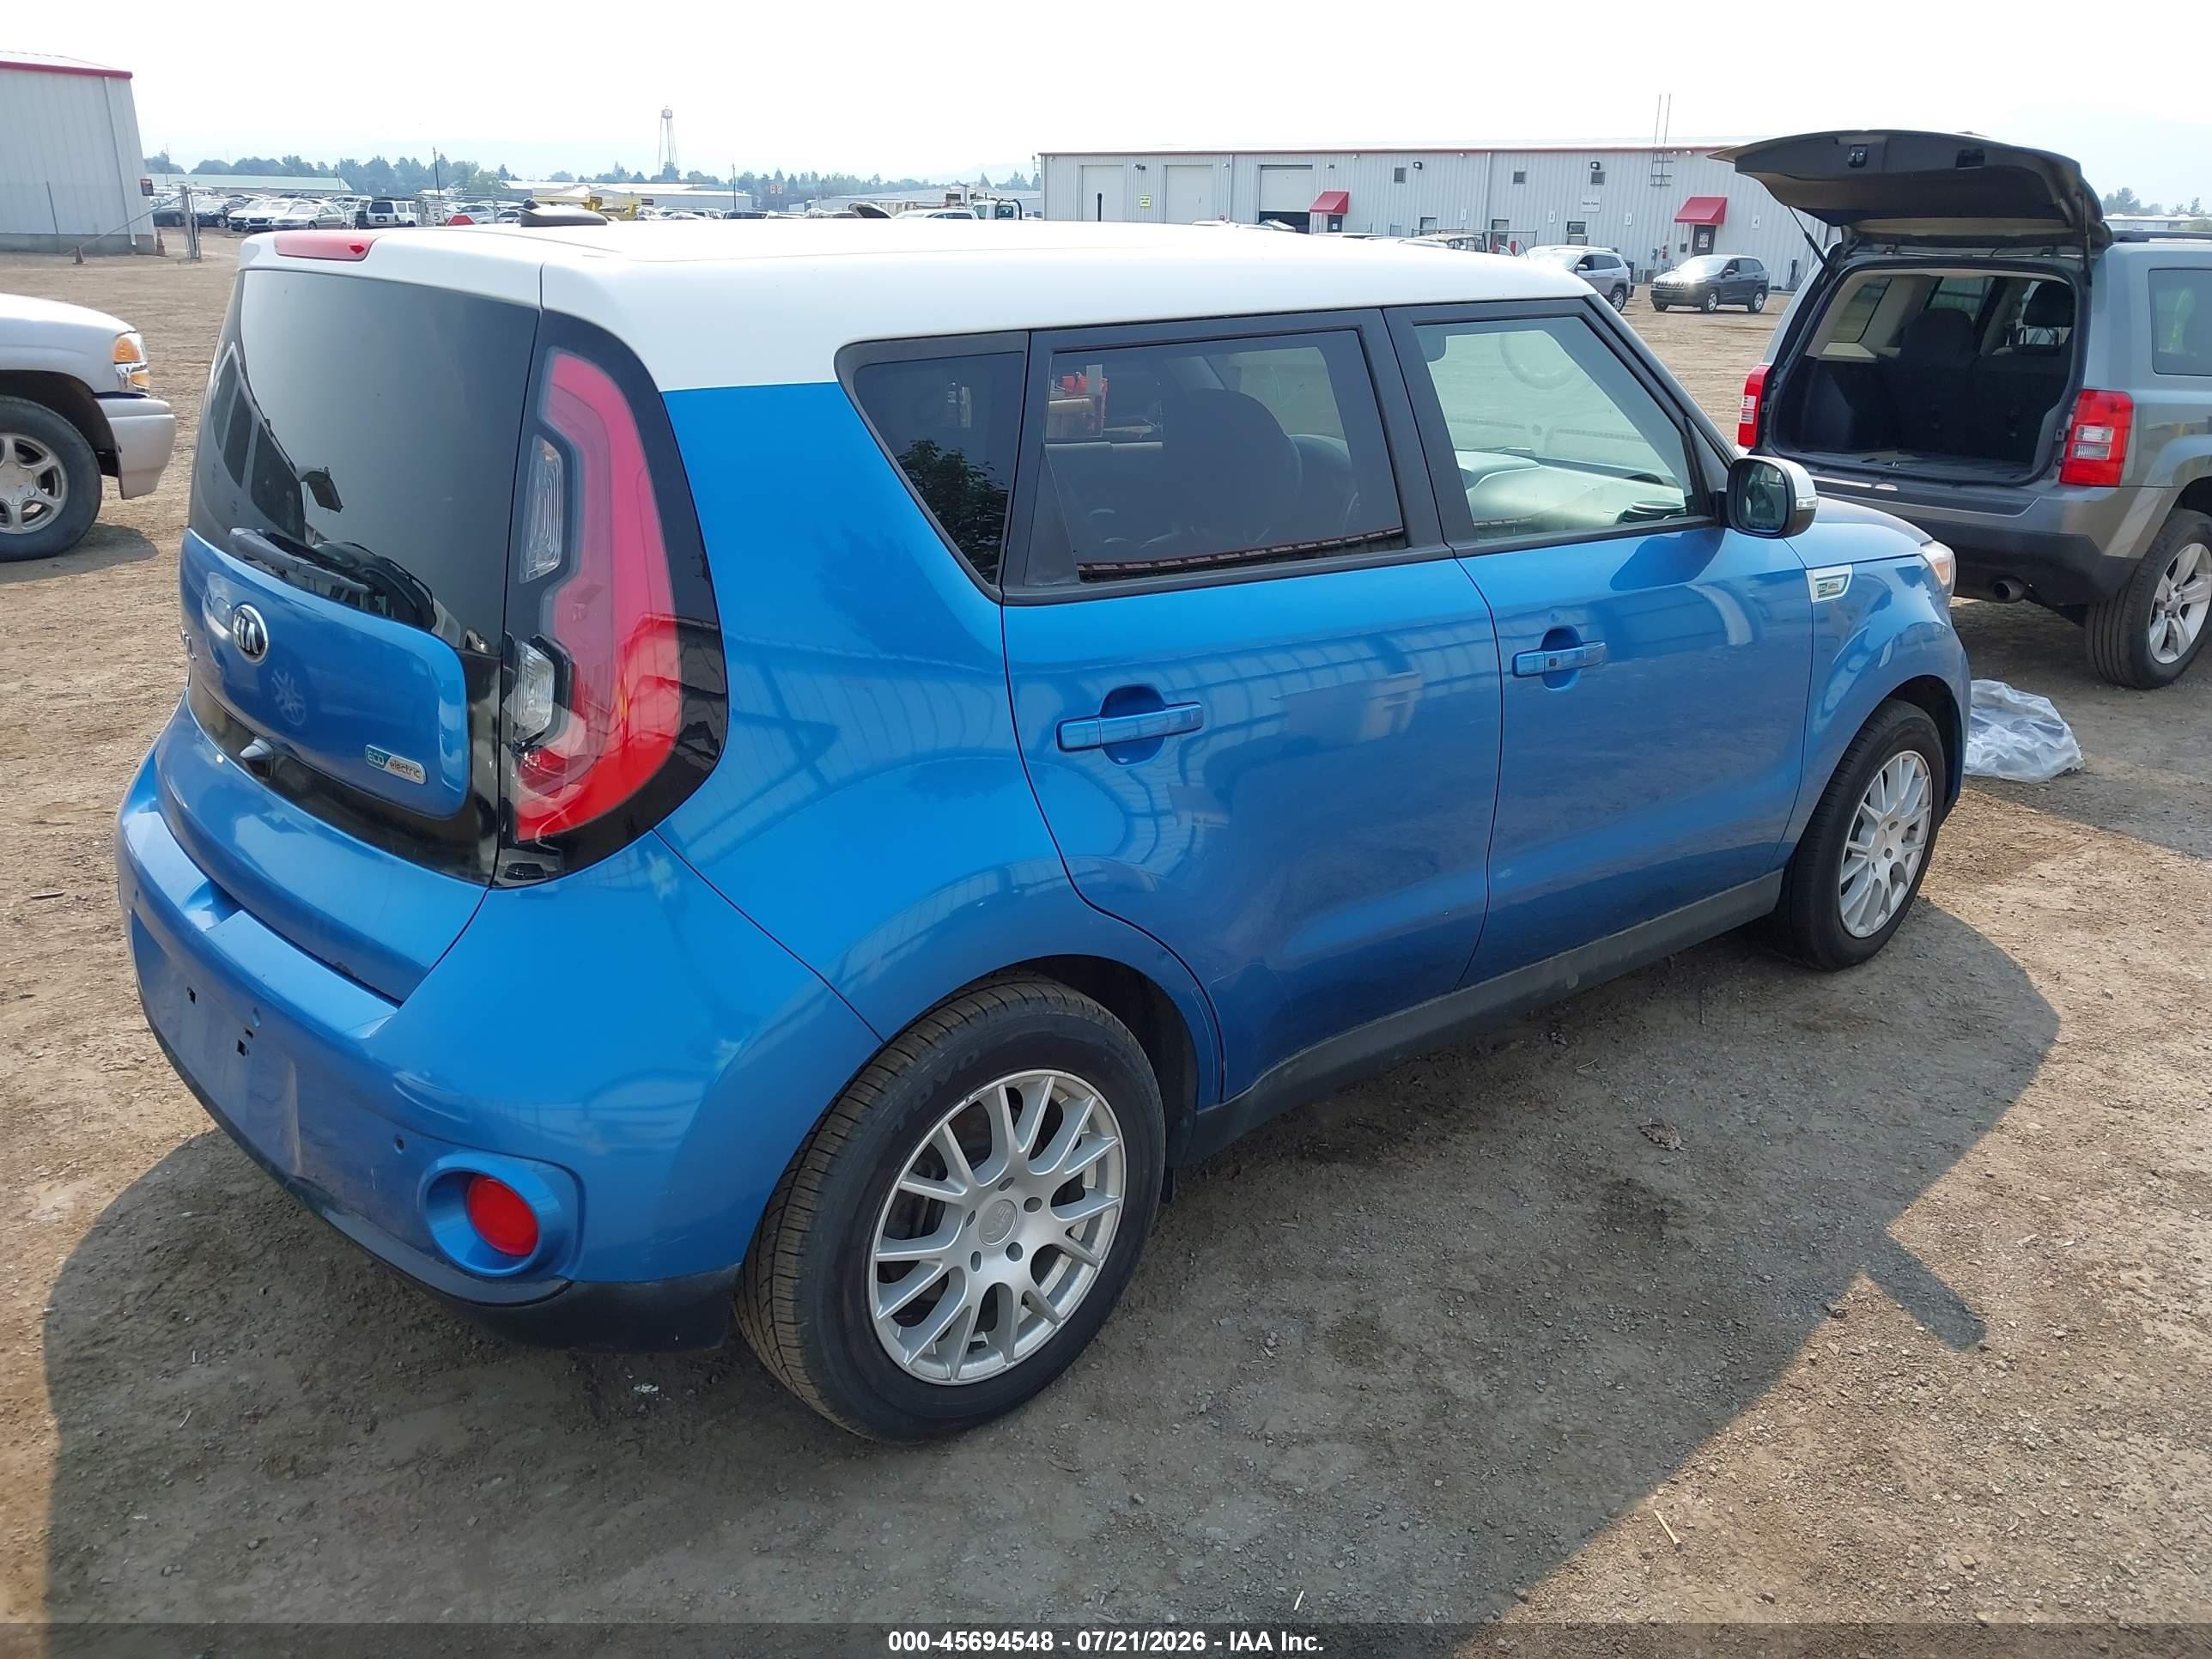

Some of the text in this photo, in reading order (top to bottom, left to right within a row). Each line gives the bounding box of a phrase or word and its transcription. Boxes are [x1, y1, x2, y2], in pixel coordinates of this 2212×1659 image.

[434, 212, 440, 221] 5
[233, 613, 259, 654] KIA
[367, 750, 421, 779] ECO electric
